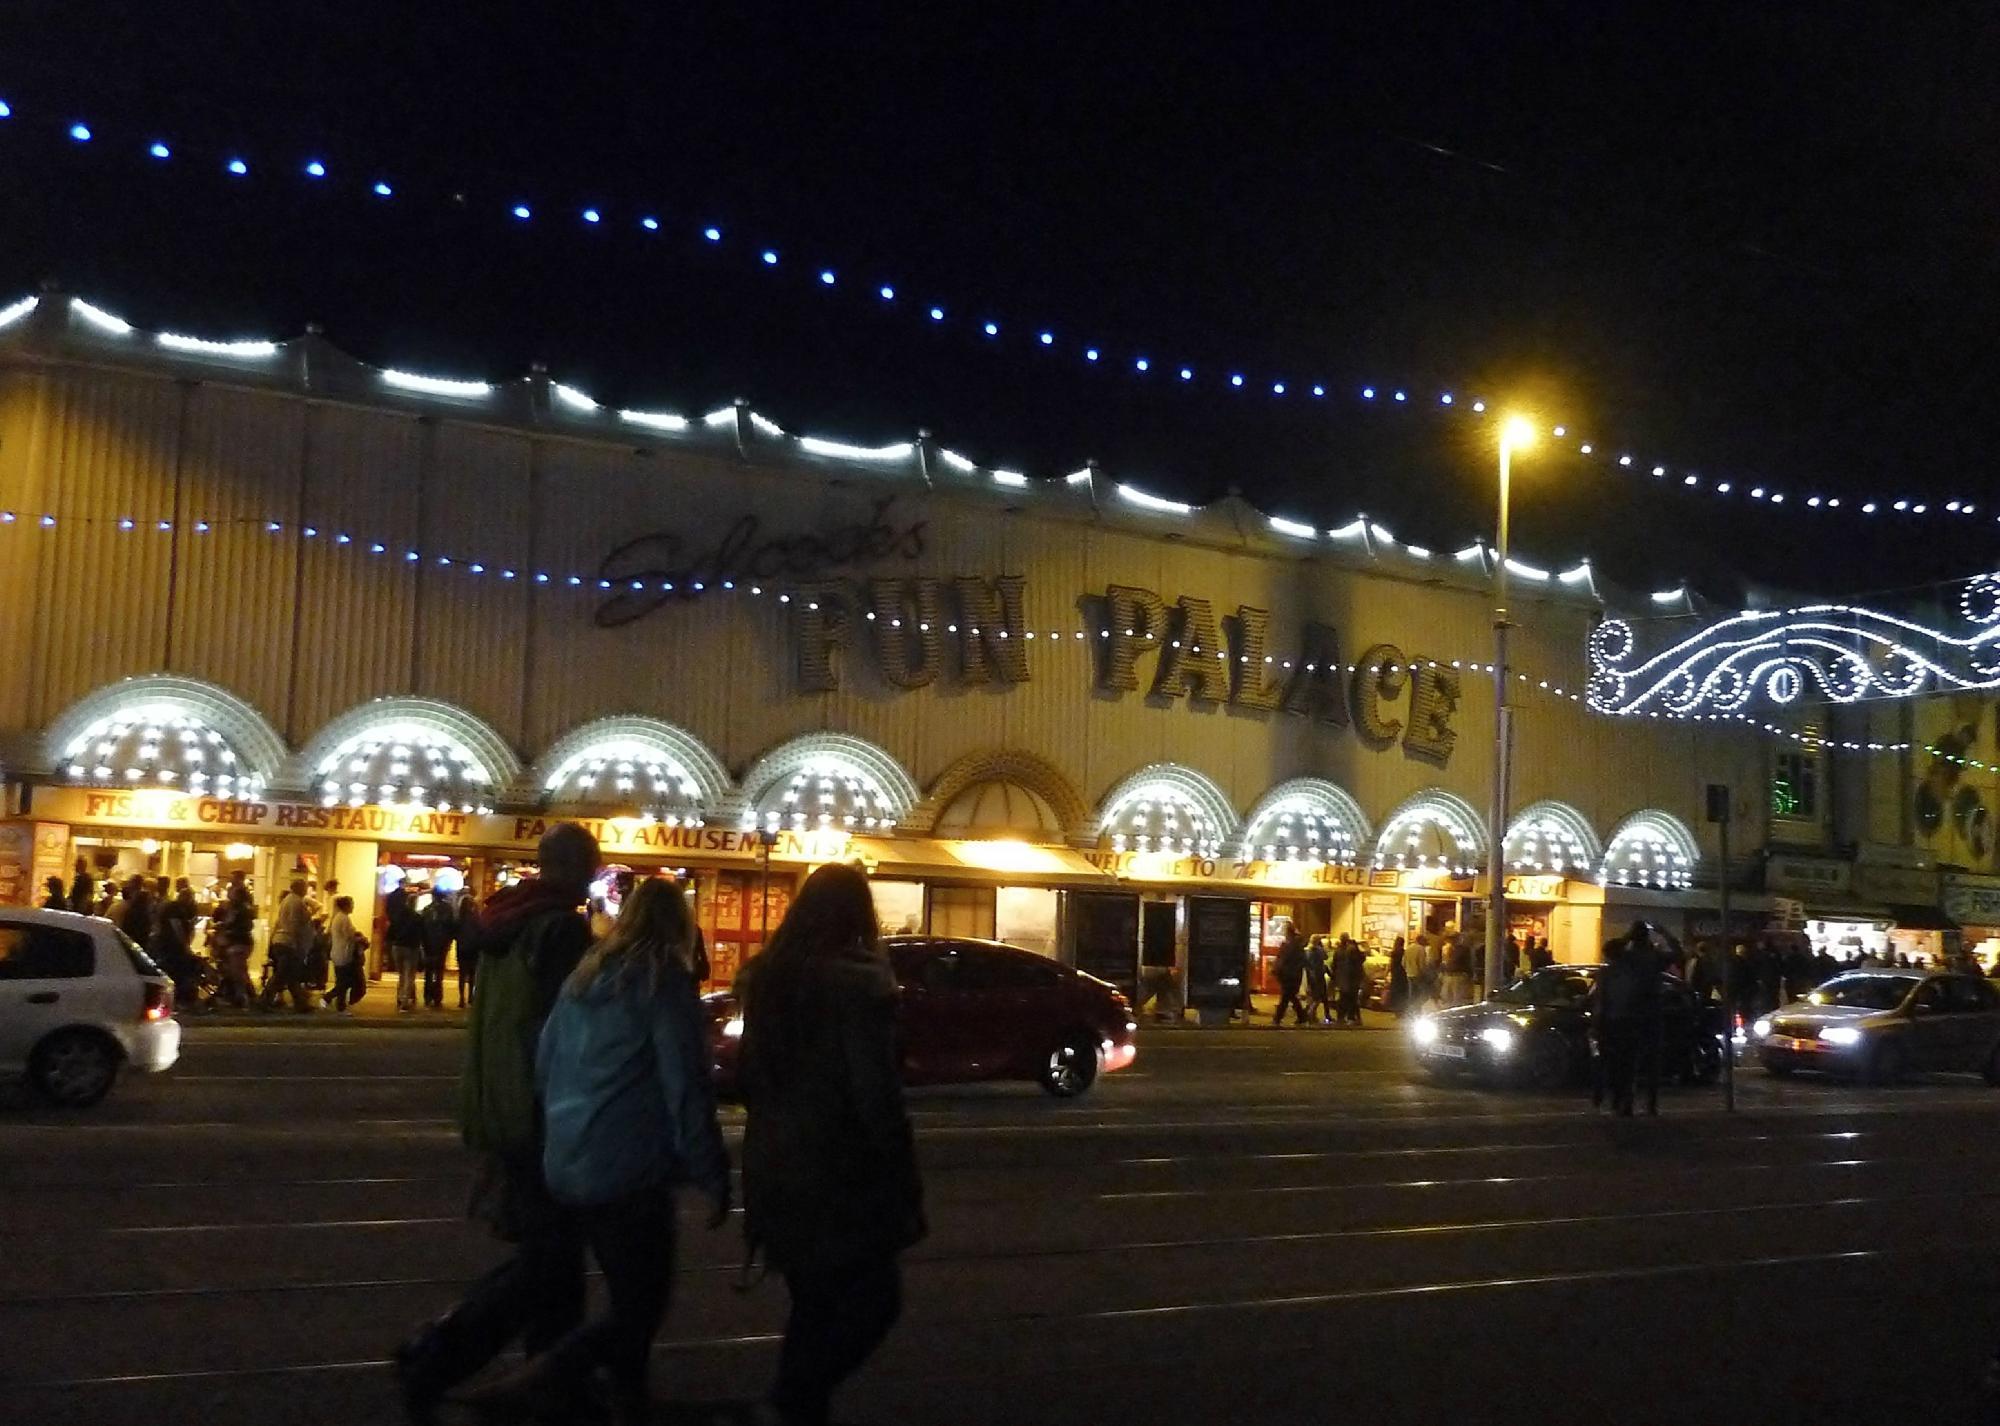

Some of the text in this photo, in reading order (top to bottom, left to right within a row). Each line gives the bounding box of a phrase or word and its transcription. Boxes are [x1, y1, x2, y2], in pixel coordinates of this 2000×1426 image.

[798, 575, 1462, 762] FUN PALACE
[86, 793, 467, 835] FIS & CHIP RESTAURANT
[515, 817, 625, 844] FALY
[1084, 853, 1181, 876] WELCE
[1190, 859, 1216, 877] TO
